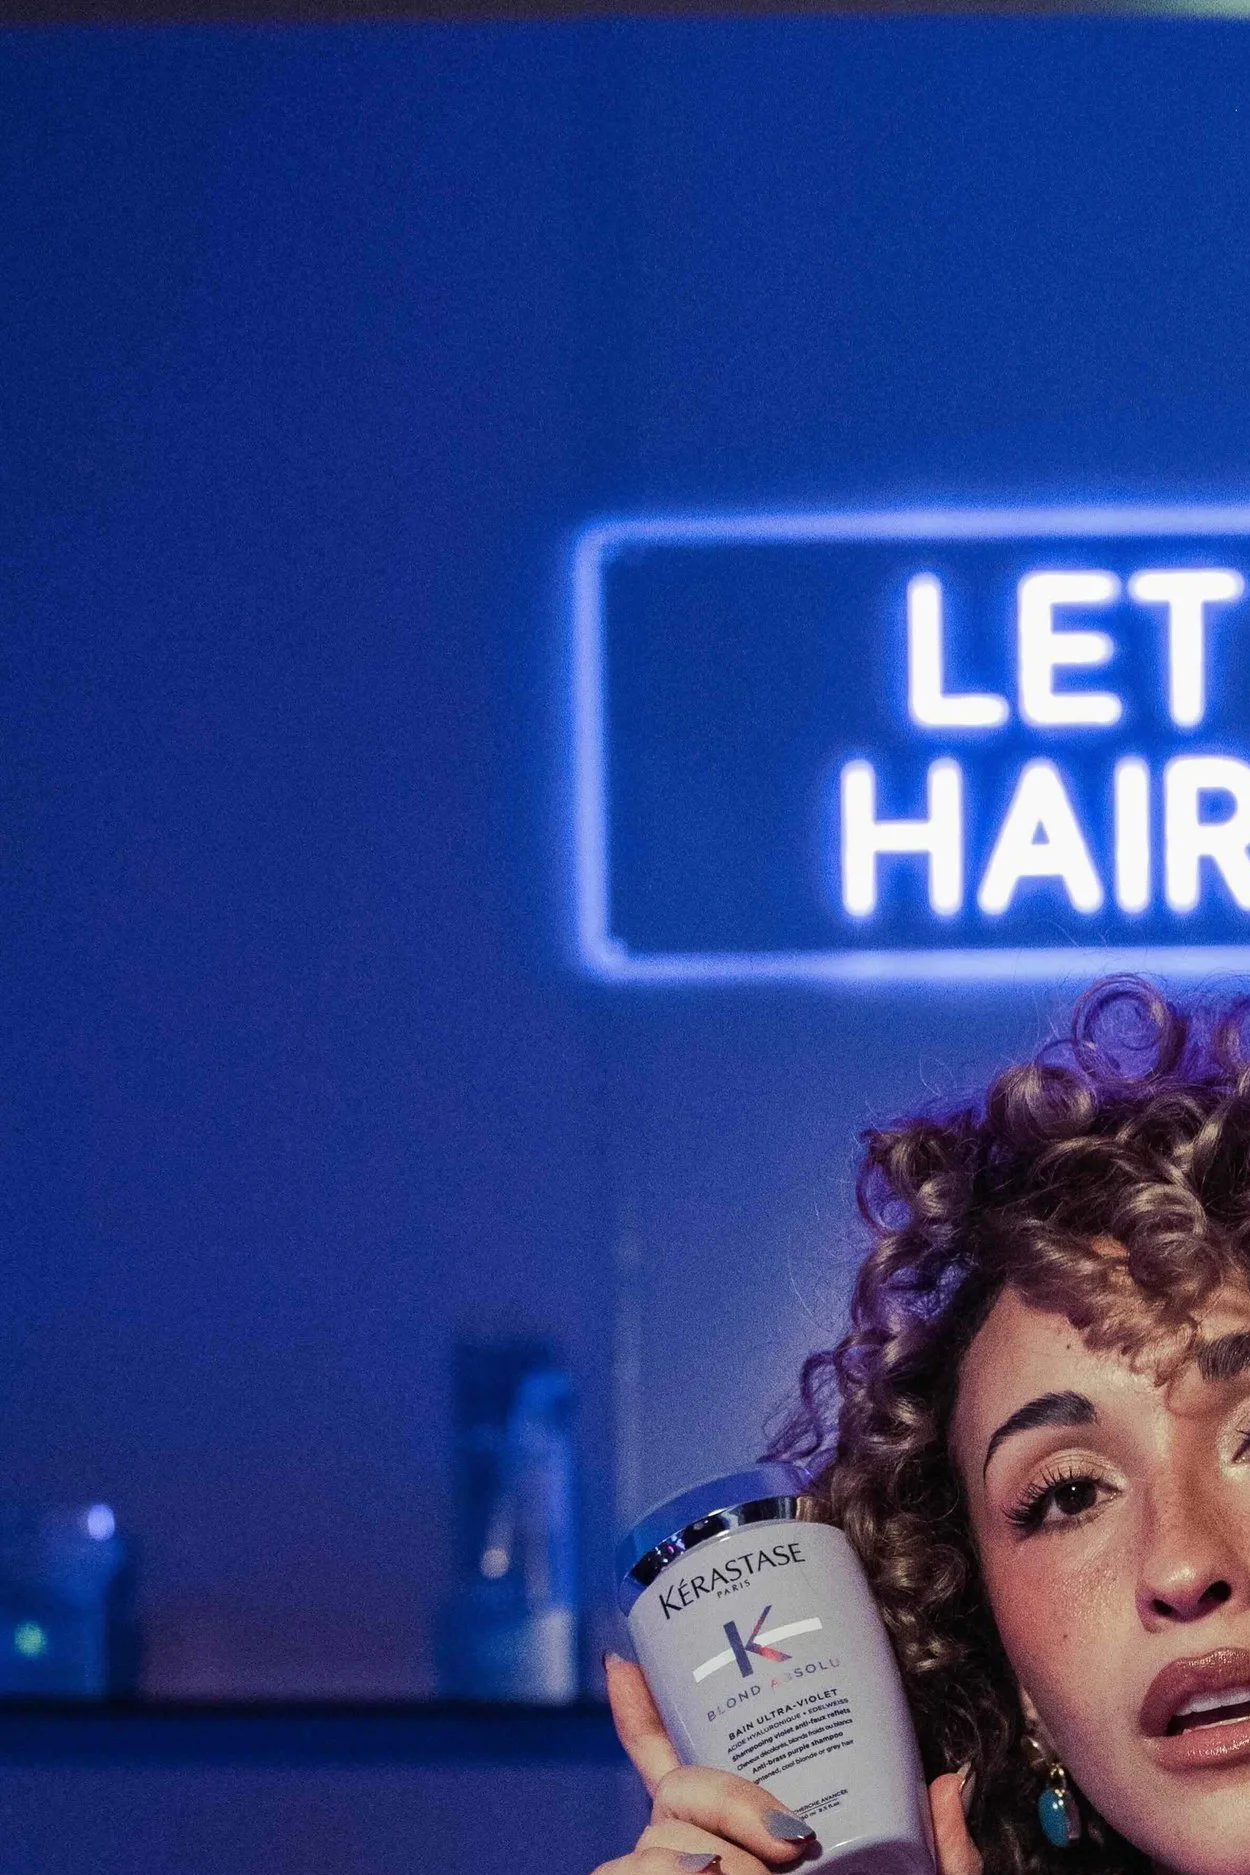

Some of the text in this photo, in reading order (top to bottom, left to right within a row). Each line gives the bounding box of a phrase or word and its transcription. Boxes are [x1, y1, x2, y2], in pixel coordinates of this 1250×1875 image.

[907, 568, 1244, 727] LET
[659, 1543, 806, 1620] KÉRASTASE
[716, 1579, 751, 1599] PARIS
[723, 1604, 793, 1678] K
[707, 1685, 761, 1722] BLOND
[727, 1739, 747, 1754] ACIDE
[747, 1713, 801, 1741] HYALURONIQUE
[808, 1698, 849, 1714] EDELWEISS
[728, 1688, 838, 1741] BAIN ULTRA-VIOLET
[732, 1707, 851, 1763] Shampooing violet anti-faux reflets
[752, 1731, 844, 1774] Anti-brass purple shampoo
[818, 1748, 825, 1756] or
[826, 1744, 841, 1754] grey
